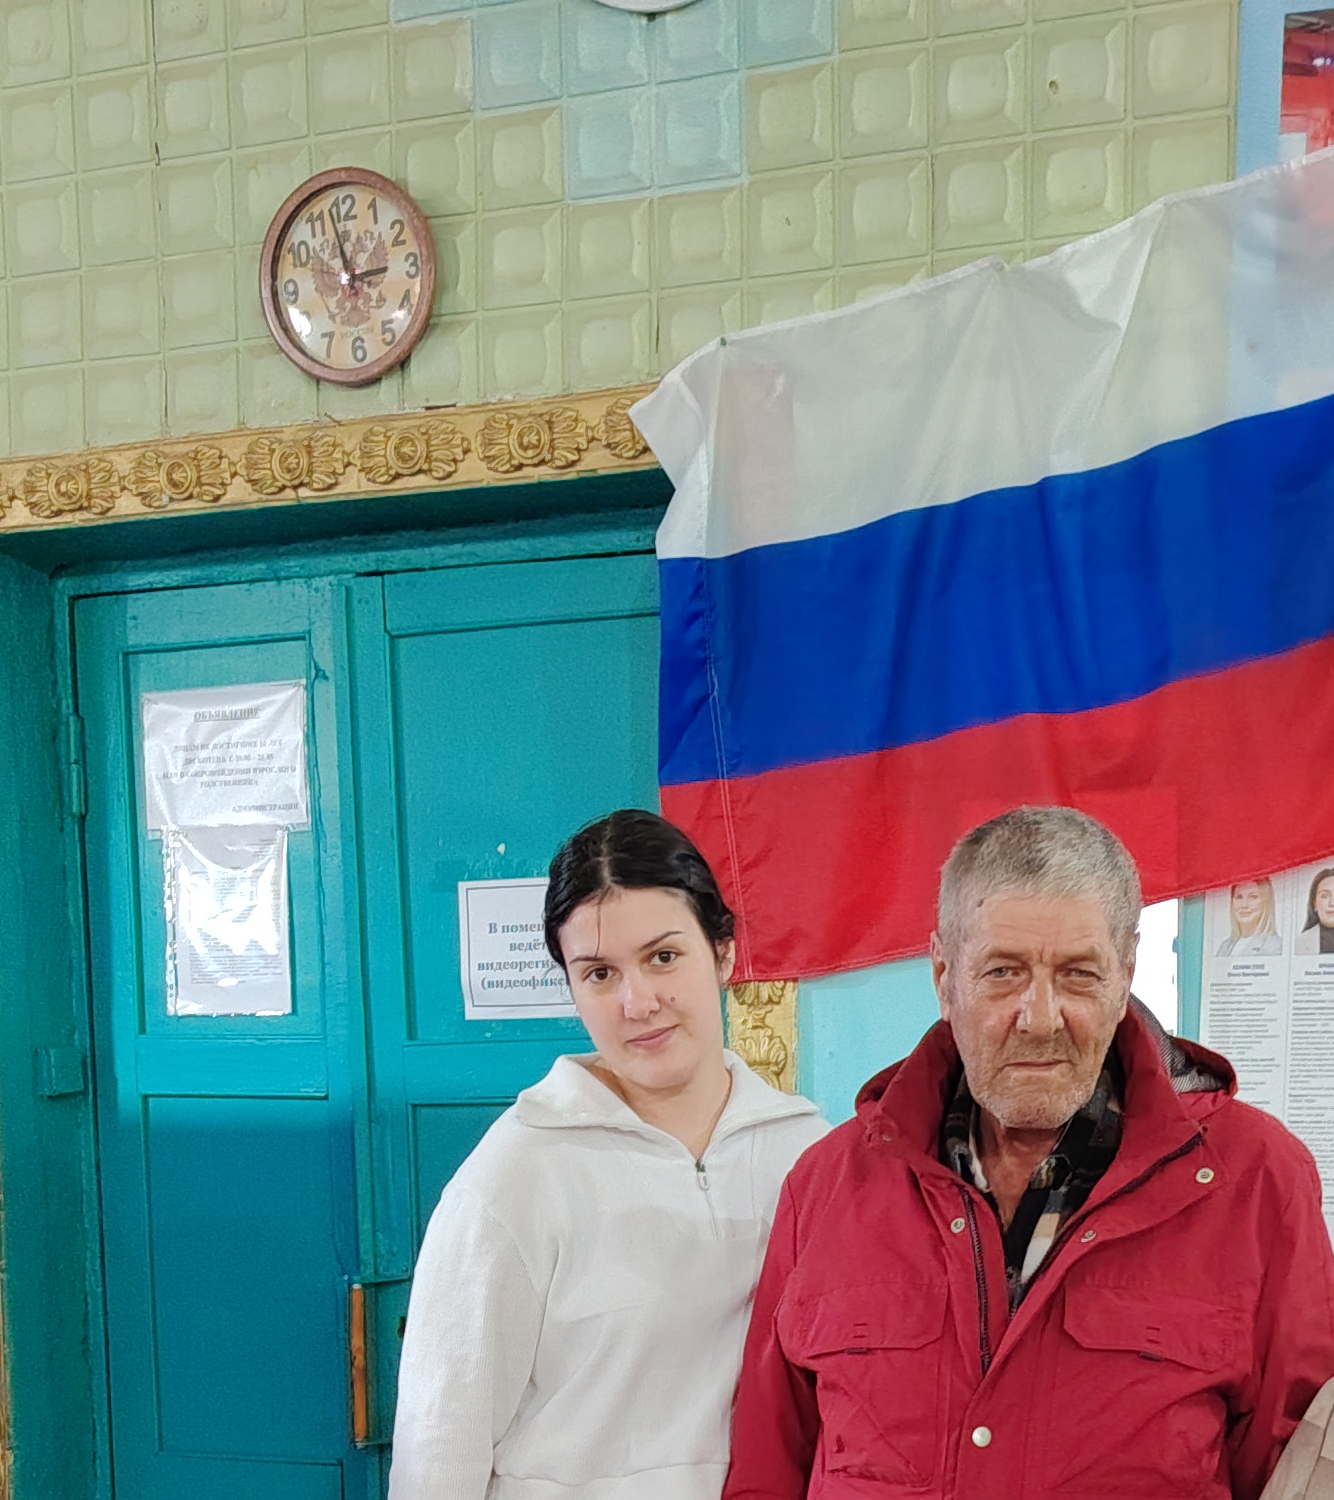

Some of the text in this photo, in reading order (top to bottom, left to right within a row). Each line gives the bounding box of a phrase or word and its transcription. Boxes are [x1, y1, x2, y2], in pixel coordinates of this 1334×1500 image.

[330, 194, 357, 223] 12
[367, 197, 379, 225] 1
[306, 210, 326, 238] 11
[390, 219, 407, 247] 2
[288, 240, 311, 268] 10
[404, 252, 419, 279] 3
[284, 279, 299, 305] 9
[321, 331, 335, 359] 7
[381, 320, 397, 346] 5
[351, 337, 367, 363] 6
[194, 708, 260, 721] ОБЪЯВЛЕНИЕ
[488, 922, 498, 934] В
